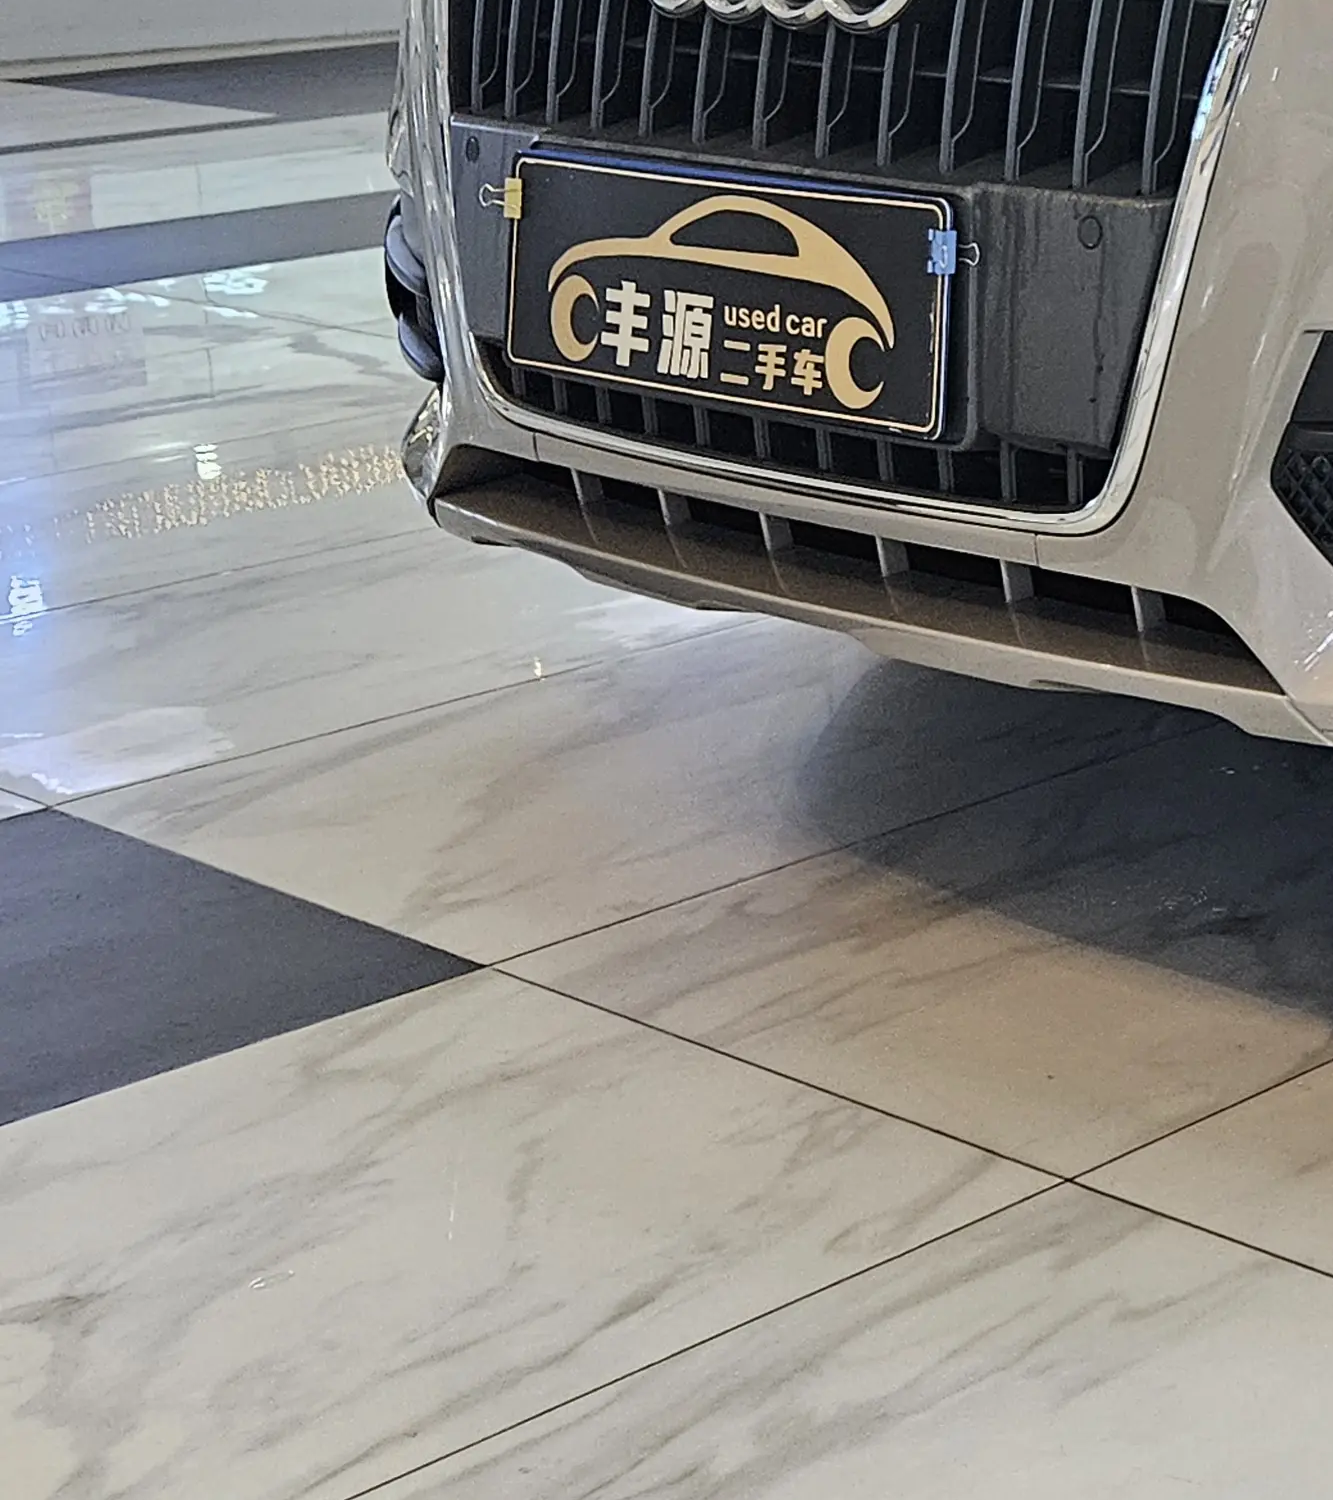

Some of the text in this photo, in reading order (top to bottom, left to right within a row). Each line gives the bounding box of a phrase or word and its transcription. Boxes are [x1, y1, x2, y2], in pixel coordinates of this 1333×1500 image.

[600, 280, 714, 379] 丰源
[723, 304, 828, 339] used car
[719, 339, 825, 397] 二手车
